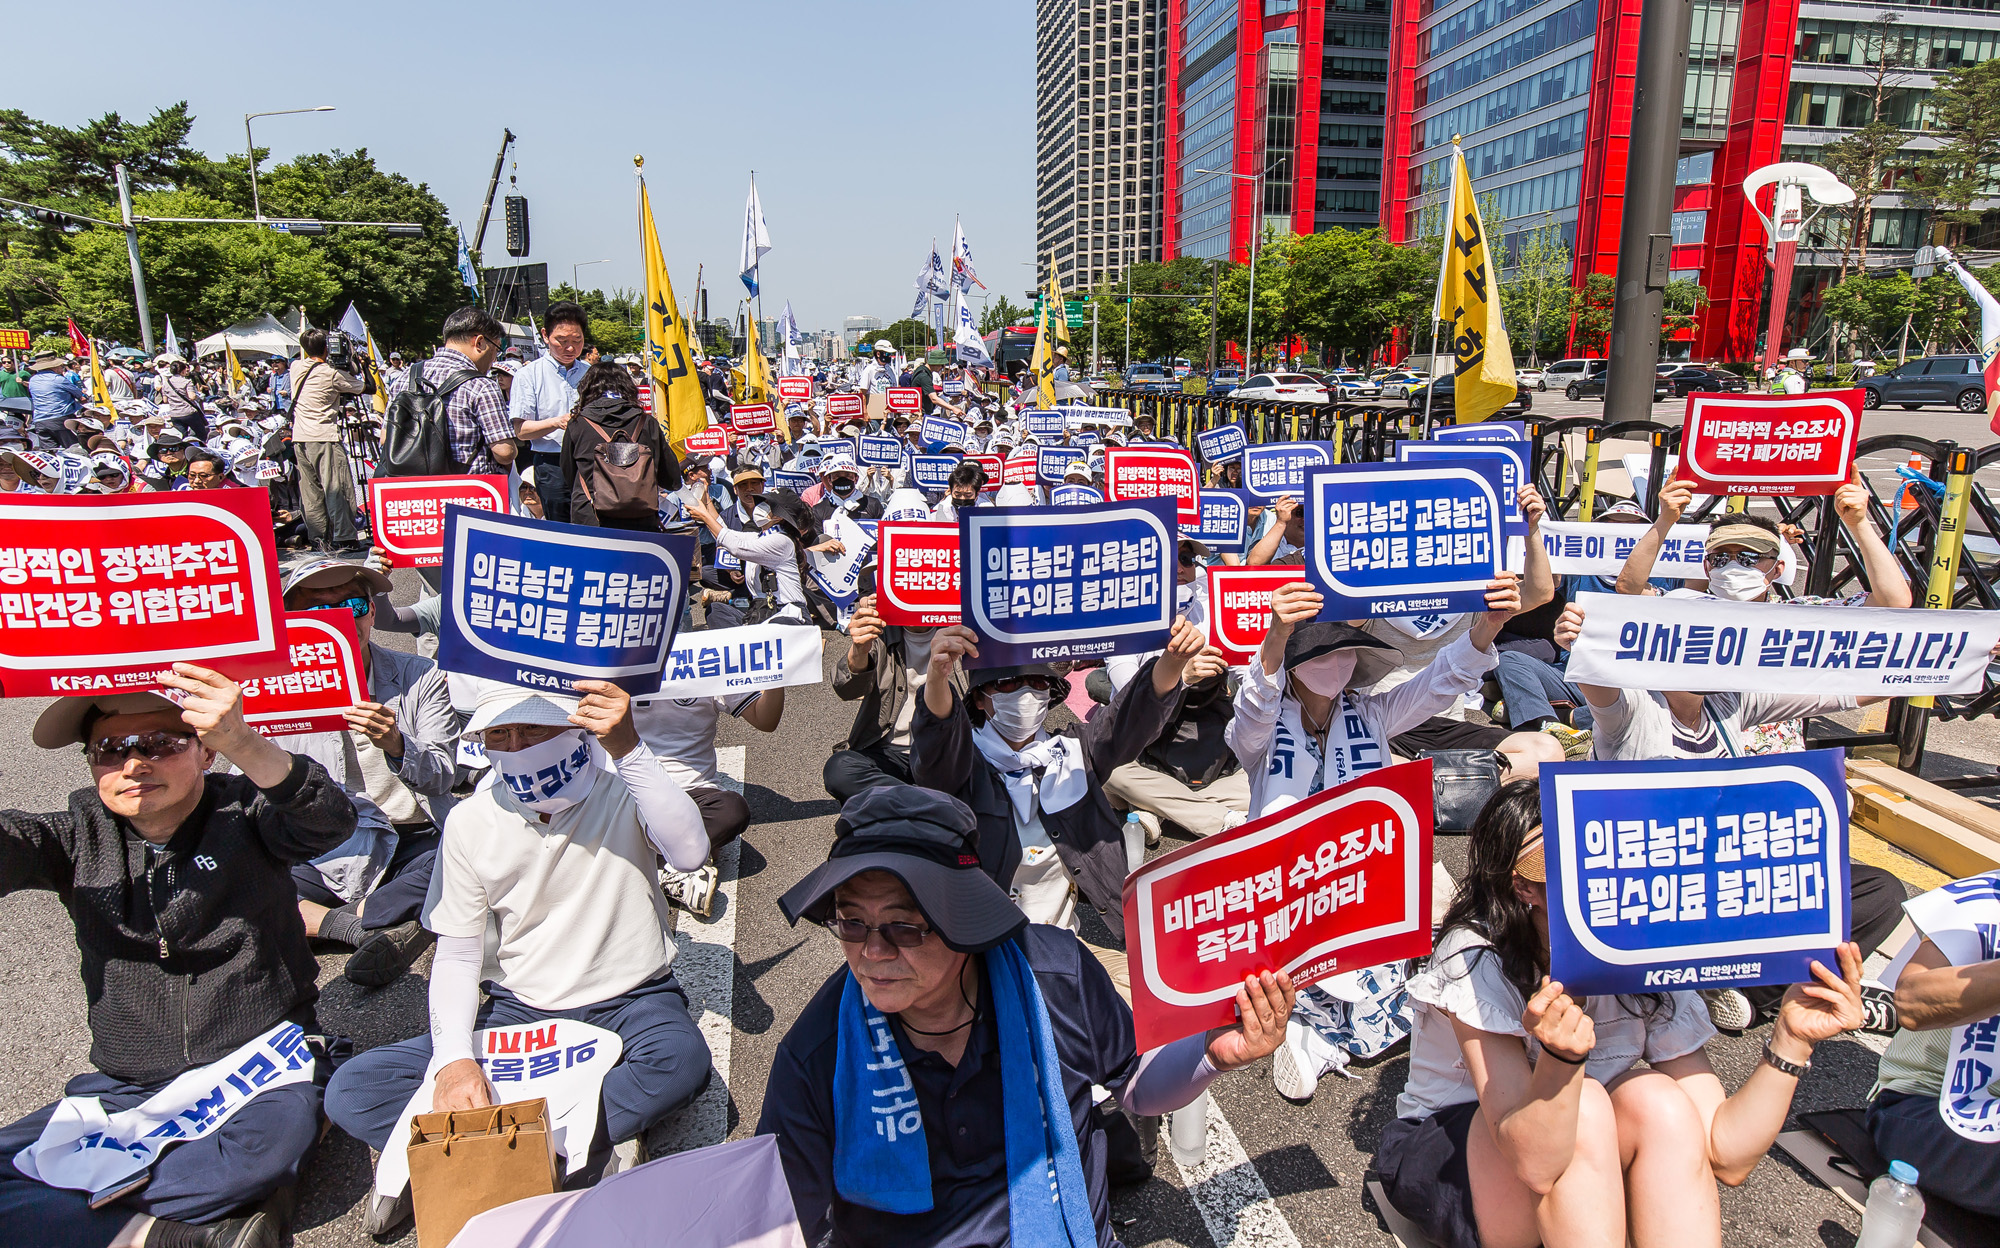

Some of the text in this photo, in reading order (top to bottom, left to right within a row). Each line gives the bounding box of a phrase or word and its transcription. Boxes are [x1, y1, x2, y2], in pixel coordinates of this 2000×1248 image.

[1702, 418, 1842, 439] 비과학적 수요조사
[1715, 442, 1822, 462] 즉각 폐기하라
[1117, 466, 1192, 483] 일방적인 정책추진
[1251, 457, 1286, 471] 의료농단
[1251, 472, 1286, 487] 필수의료
[1117, 483, 1193, 499] 국민건강 위협한다
[385, 499, 437, 517] 일방적인
[1203, 503, 1239, 519] 교육농단
[1328, 496, 1488, 535] 의료농단 교육농단
[386, 518, 438, 536] 국민건강
[1203, 520, 1239, 534] 붕괴된다
[101, 540, 239, 582] 정책추진
[895, 547, 951, 568] 일방적인
[987, 544, 1074, 581] 의료농단
[1080, 535, 1159, 576] 교육농단
[1329, 533, 1491, 573] 필수의료 붕괴된다
[469, 552, 670, 609] 의료농단 교육농단
[894, 571, 951, 591] 국민건강
[0, 582, 245, 630] 민건강 위협한다
[988, 574, 1159, 620] 필수의료 붕괴된다
[1223, 590, 1273, 609] 비과학적
[1371, 601, 1408, 613] KMA
[1408, 598, 1448, 608] 대한의사협회
[469, 591, 663, 648] 필수의료 붕괴된다
[1237, 613, 1262, 632] 즉각
[290, 641, 338, 669] 추진
[1032, 641, 1115, 659] KMA 대한의사협회
[1615, 620, 1970, 670] 의사들이 살리겠습니다!
[661, 638, 783, 681] 겠습니다!
[50, 674, 114, 691] KMA
[262, 667, 342, 696] 위협한다
[516, 669, 560, 689] KMA
[1882, 674, 1912, 684] KMA
[1584, 807, 1823, 870] 의료농단 교육농단
[1162, 819, 1396, 934] 비과학적 수요조사
[1587, 862, 1825, 927] 필수의료 붕괴된다
[1196, 871, 1367, 965] 즉각 폐기하라
[1292, 957, 1337, 985] 한의사협회
[1644, 962, 1762, 986] KMA 대한의사협회
[475, 1038, 598, 1082] 의료붕
